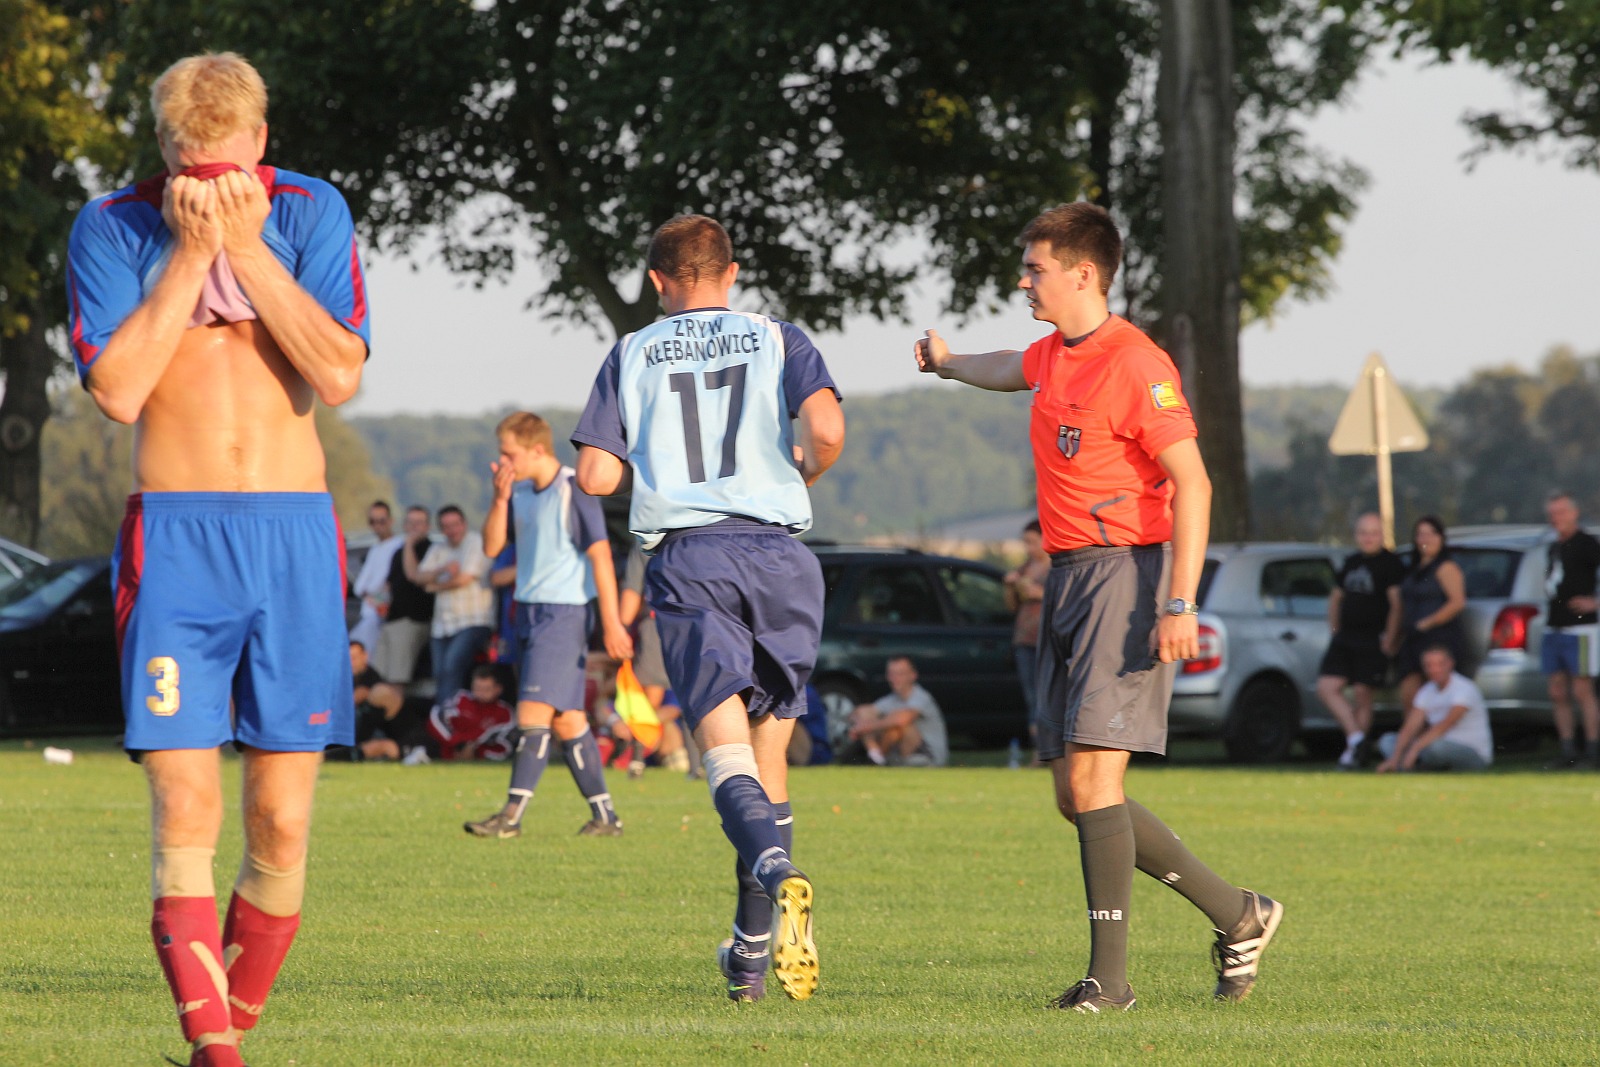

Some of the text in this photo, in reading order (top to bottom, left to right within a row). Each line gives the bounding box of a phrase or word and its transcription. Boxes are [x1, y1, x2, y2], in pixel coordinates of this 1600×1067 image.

[643, 331, 760, 367] KŁĘBANOWICE
[673, 316, 723, 338] ZRYW
[669, 363, 748, 484] 17
[146, 656, 180, 717] 3
